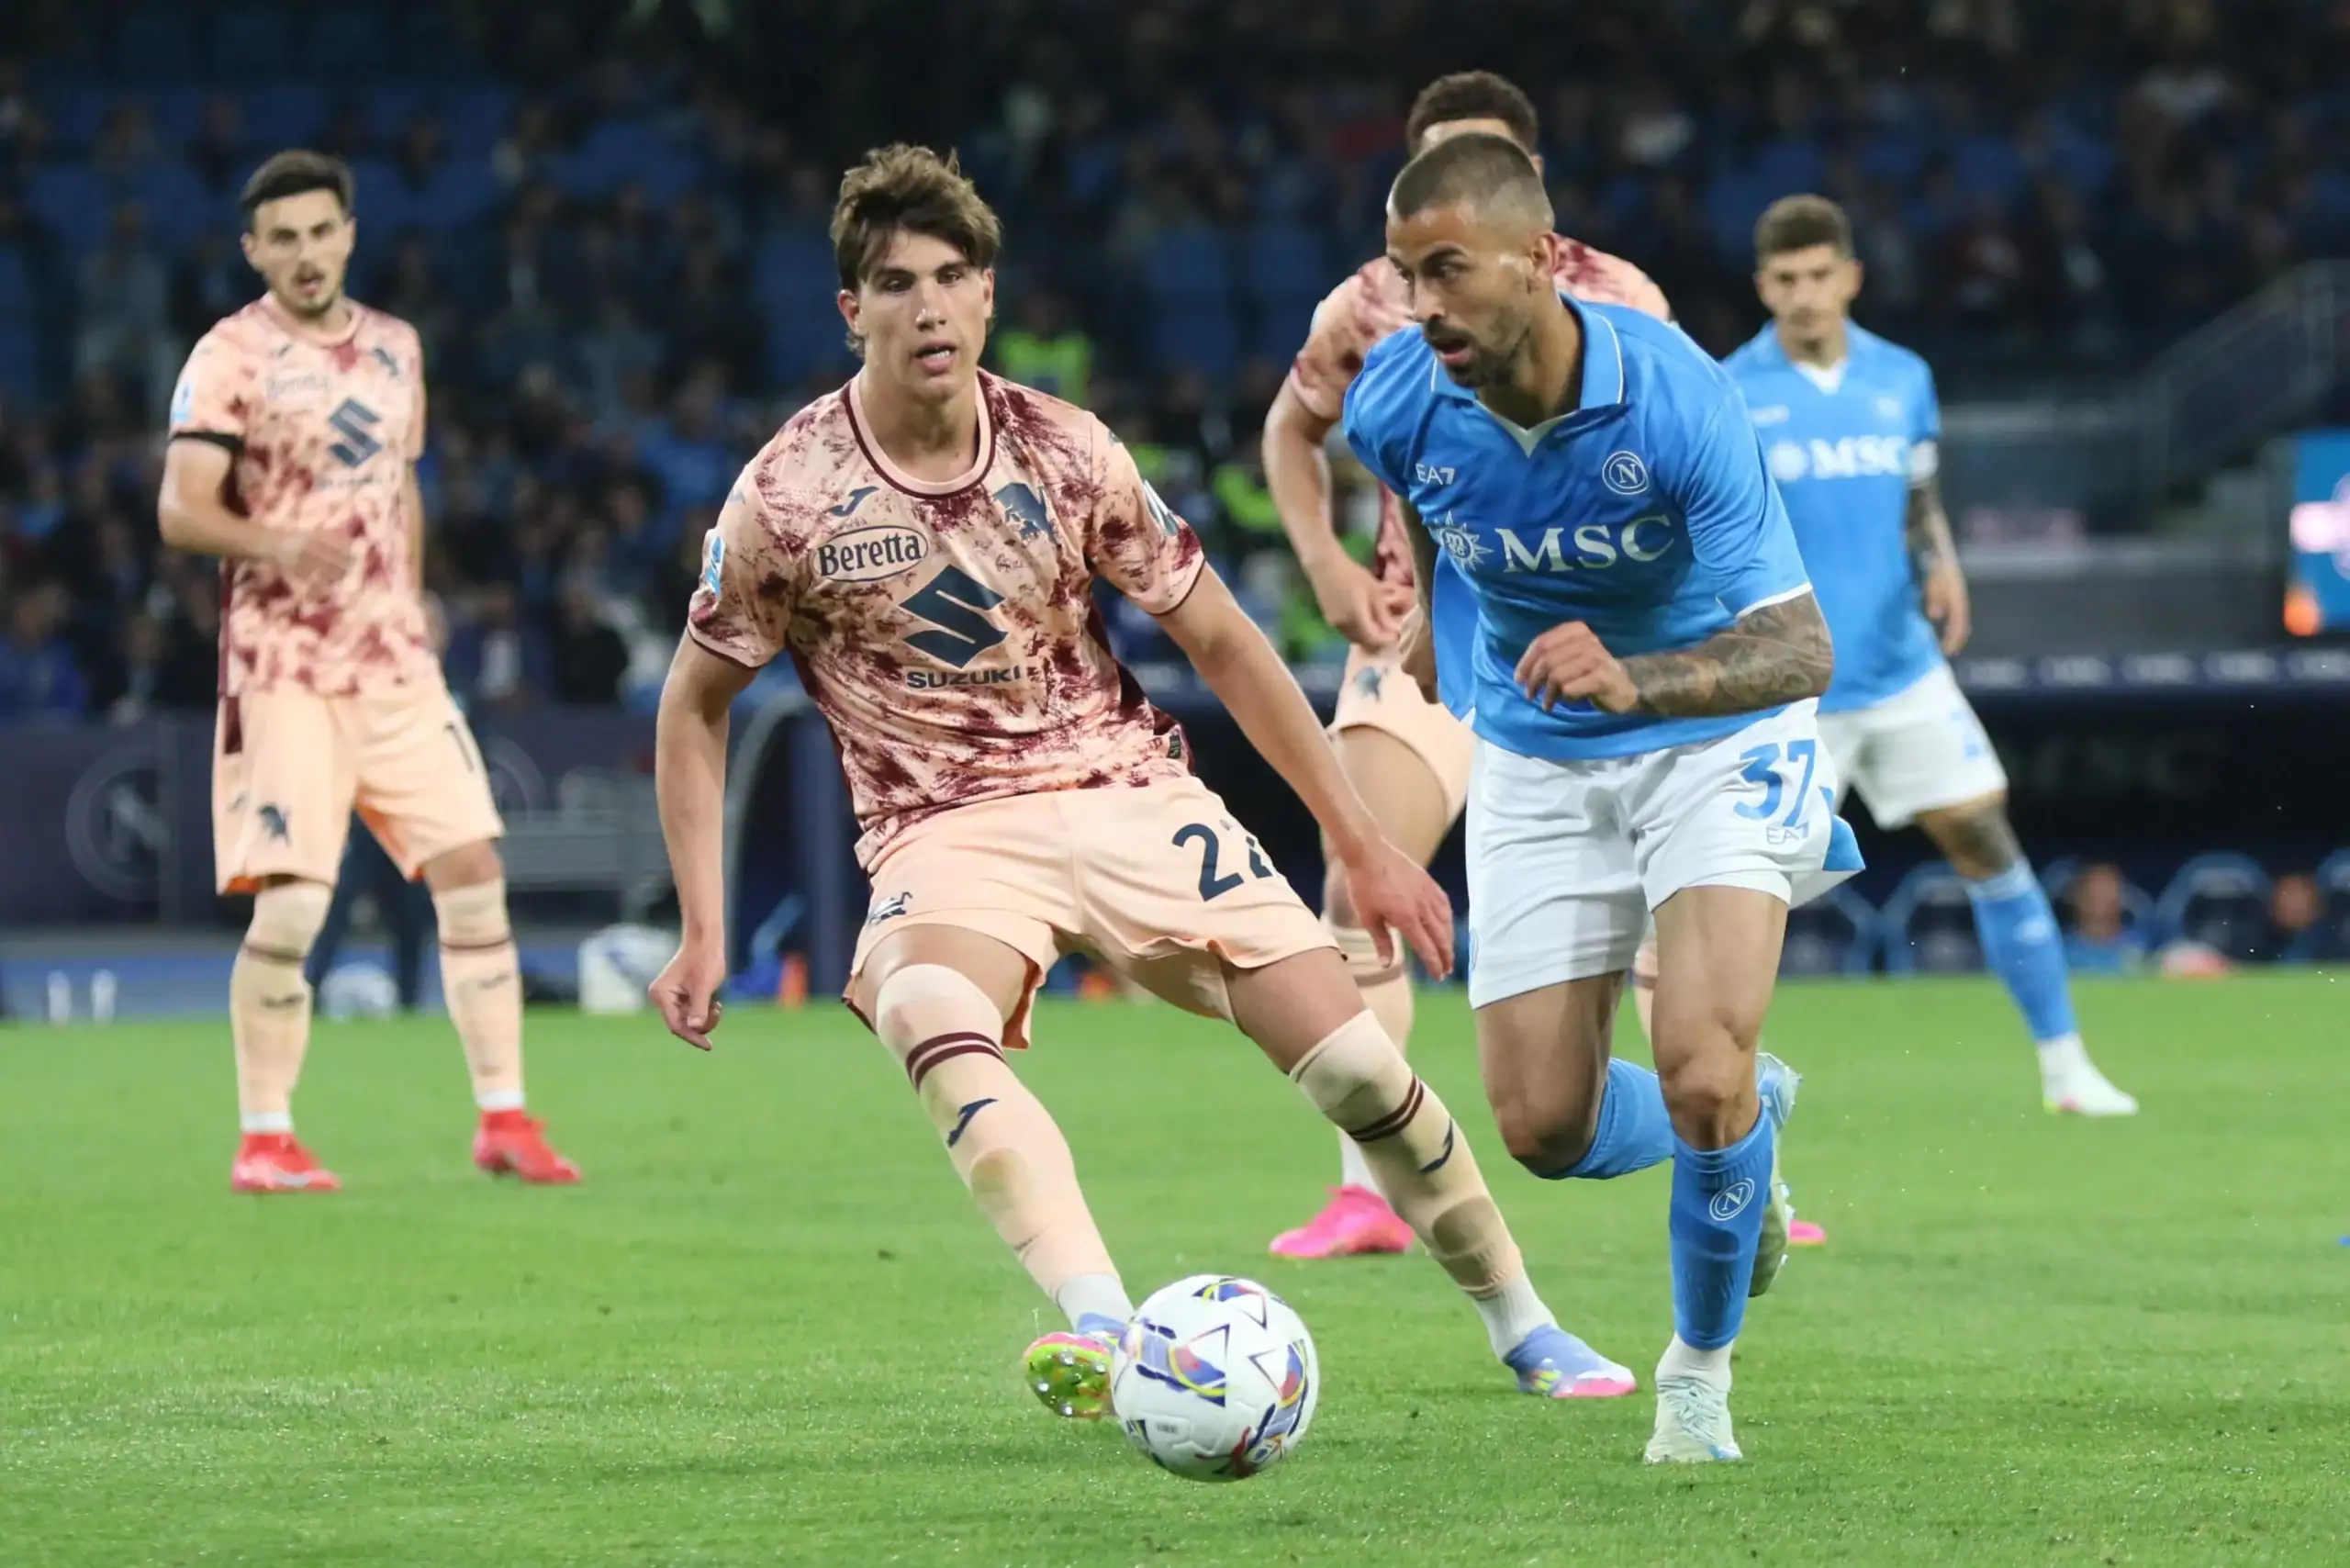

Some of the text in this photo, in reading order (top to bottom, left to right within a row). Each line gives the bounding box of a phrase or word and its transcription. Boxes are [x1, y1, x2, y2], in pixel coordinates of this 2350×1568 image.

[1416, 463, 1455, 485] EA7
[818, 533, 922, 577] Beretta
[1494, 515, 1674, 573] MSC
[906, 666, 1021, 689] SUZUKI
[1733, 739, 1816, 827] 37
